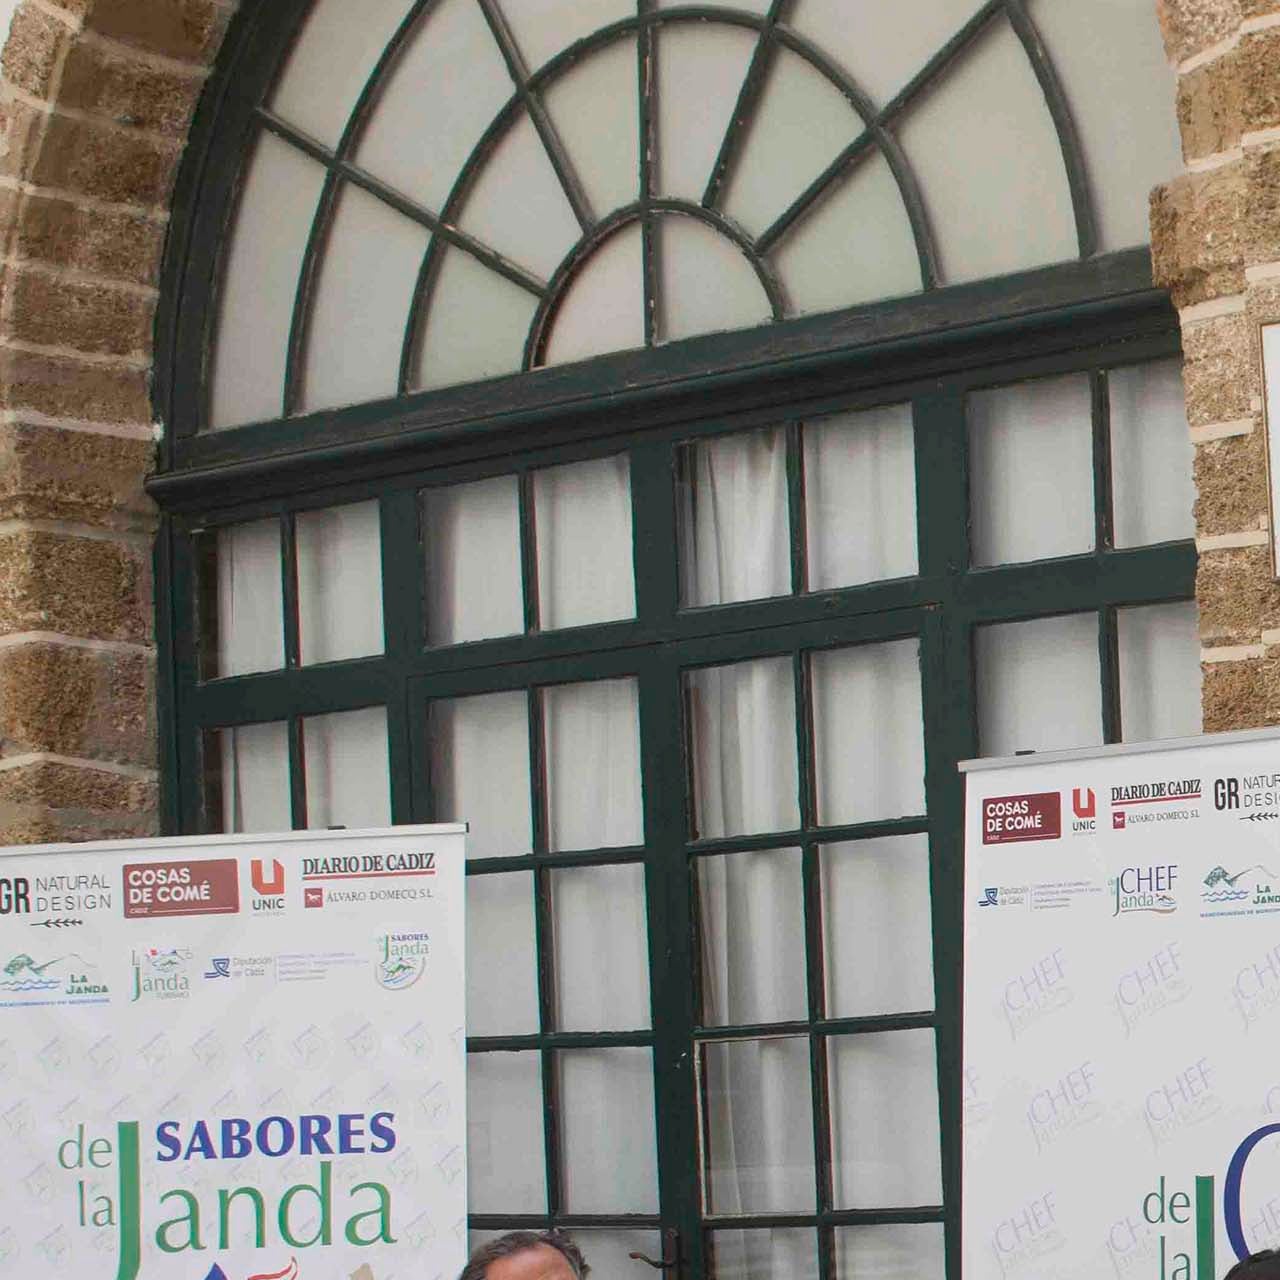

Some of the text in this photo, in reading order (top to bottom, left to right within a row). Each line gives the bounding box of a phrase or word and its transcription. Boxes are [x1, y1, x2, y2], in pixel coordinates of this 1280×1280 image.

[1110, 784, 1152, 802] DIARIO
[1151, 782, 1167, 798] DE
[1214, 777, 1240, 811] GR
[986, 800, 1030, 817] COSAS
[986, 810, 1043, 833] DE COMÉ
[1072, 820, 1097, 832] UNIC
[302, 852, 436, 876] DIARIO DE CADIZ
[36, 874, 112, 893] NATURAL
[127, 867, 192, 886] COSAS
[1120, 864, 1179, 895] CHEF
[129, 880, 212, 905] DE COMÉ
[1256, 884, 1271, 894] LA
[36, 893, 113, 913] DESIGN
[252, 898, 286, 912] UNIC
[65, 984, 109, 995] JANDA
[57, 1123, 113, 1170] de
[155, 1112, 398, 1163] SABORES
[78, 1180, 117, 1227] la
[1142, 1175, 1191, 1225] de
